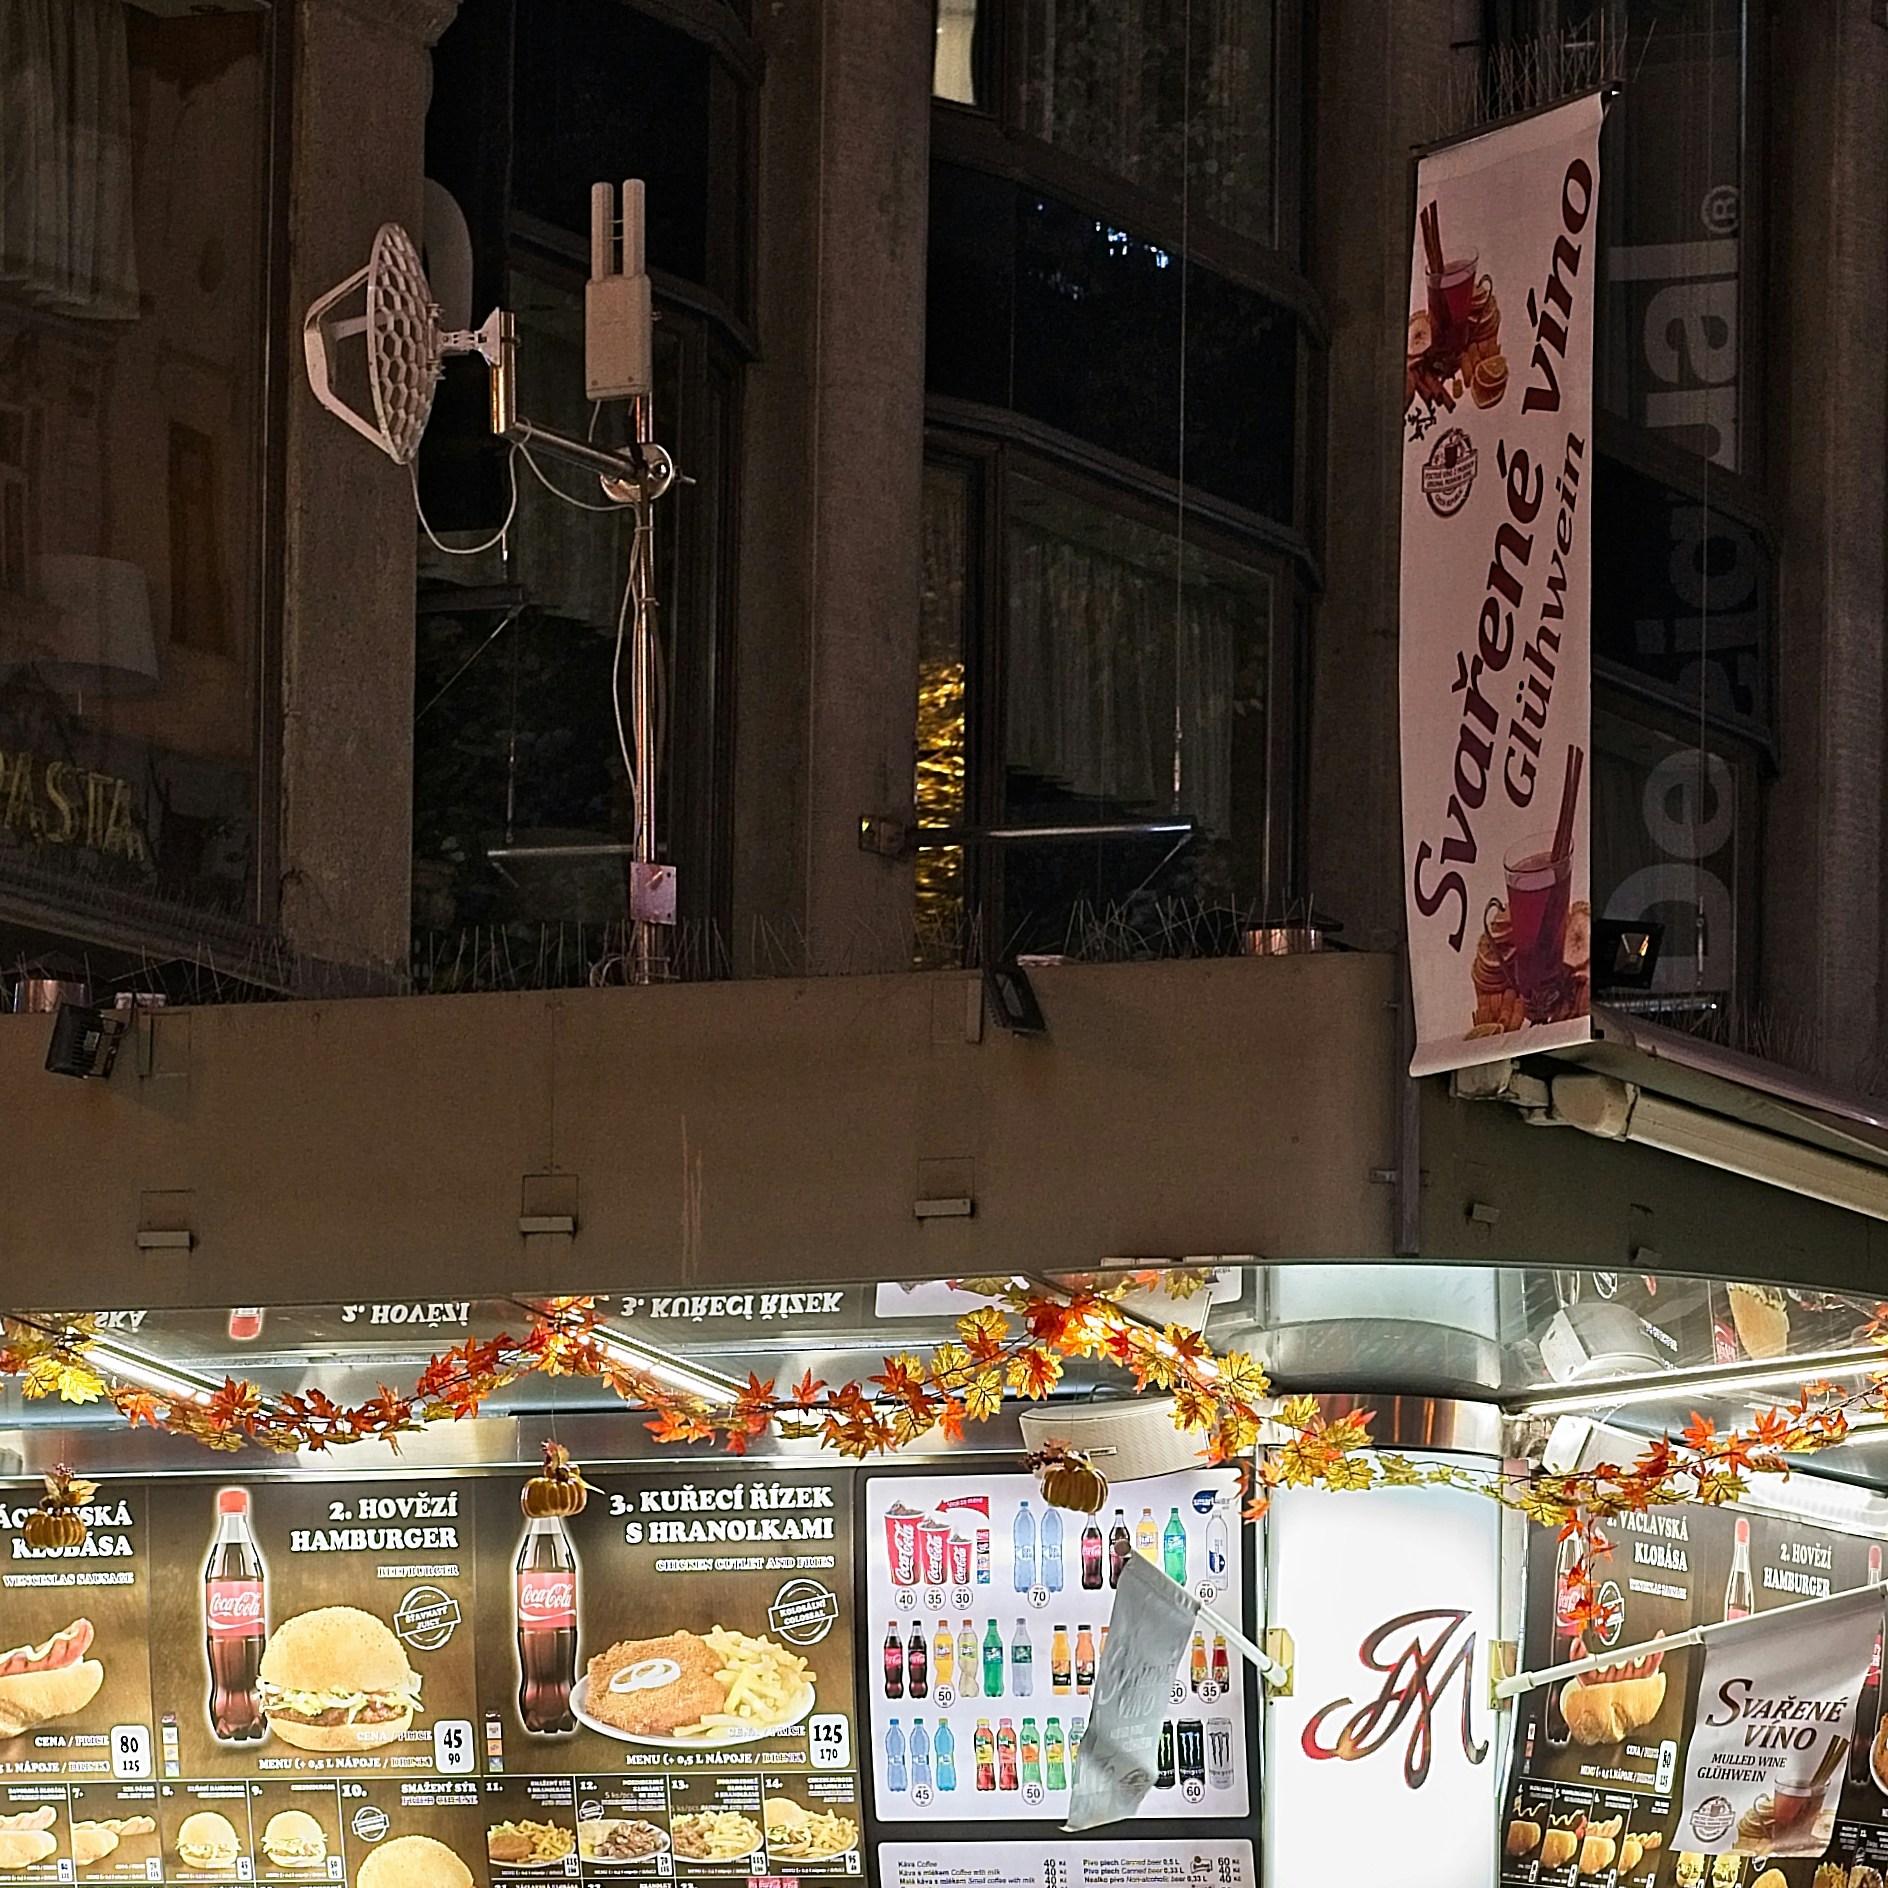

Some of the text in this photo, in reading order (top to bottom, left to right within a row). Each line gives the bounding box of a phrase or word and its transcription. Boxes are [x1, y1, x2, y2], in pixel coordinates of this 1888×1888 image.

[1413, 447, 1546, 950] Svařené
[1521, 156, 1594, 414] víno
[1503, 434, 1585, 810] Glühwein
[329, 1491, 458, 1521] 2. HOVĚZÍ
[610, 1482, 833, 1515] 3. KUŘECÍ ŘÍZEK
[290, 1527, 458, 1552] HAMBURGER
[626, 1518, 833, 1544] S HRANOLKAMI
[1634, 1543, 1688, 1572] KLOBÁSA
[1792, 1543, 1832, 1570] HOVĚZÍ
[1763, 1567, 1831, 1597] HAMBURGER
[522, 1583, 572, 1608] Coca-Cola
[899, 1594, 913, 1604] 40
[928, 1594, 942, 1605] 35
[955, 1593, 969, 1604] 30
[1032, 1591, 1046, 1602] 70
[1198, 1588, 1214, 1598] 60
[209, 1592, 261, 1616] Coca-Cola
[938, 1691, 952, 1702] 50
[1203, 1687, 1217, 1698] 35
[1706, 1678, 1848, 1727] SVAŘENÉ
[444, 1729, 462, 1748] 45
[814, 1724, 842, 1743] 125
[1744, 1720, 1817, 1751] VÍNO
[35, 1735, 139, 1754] CENA 80
[259, 1758, 292, 1770] MENU
[449, 1753, 460, 1765] 90
[626, 1749, 837, 1765] MENU NÁPOJE 170
[1711, 1753, 1787, 1768] MULLED WINE
[1697, 1765, 1767, 1782] GLÜHWEIN
[342, 1784, 368, 1797] 10.
[486, 1782, 503, 1791] 11.
[580, 1781, 597, 1791] 12.
[672, 1780, 689, 1790] 13.
[766, 1778, 783, 1789] 14.
[1186, 1786, 1201, 1796] 60
[915, 1789, 929, 1800] 45
[1026, 1788, 1040, 1798] 50
